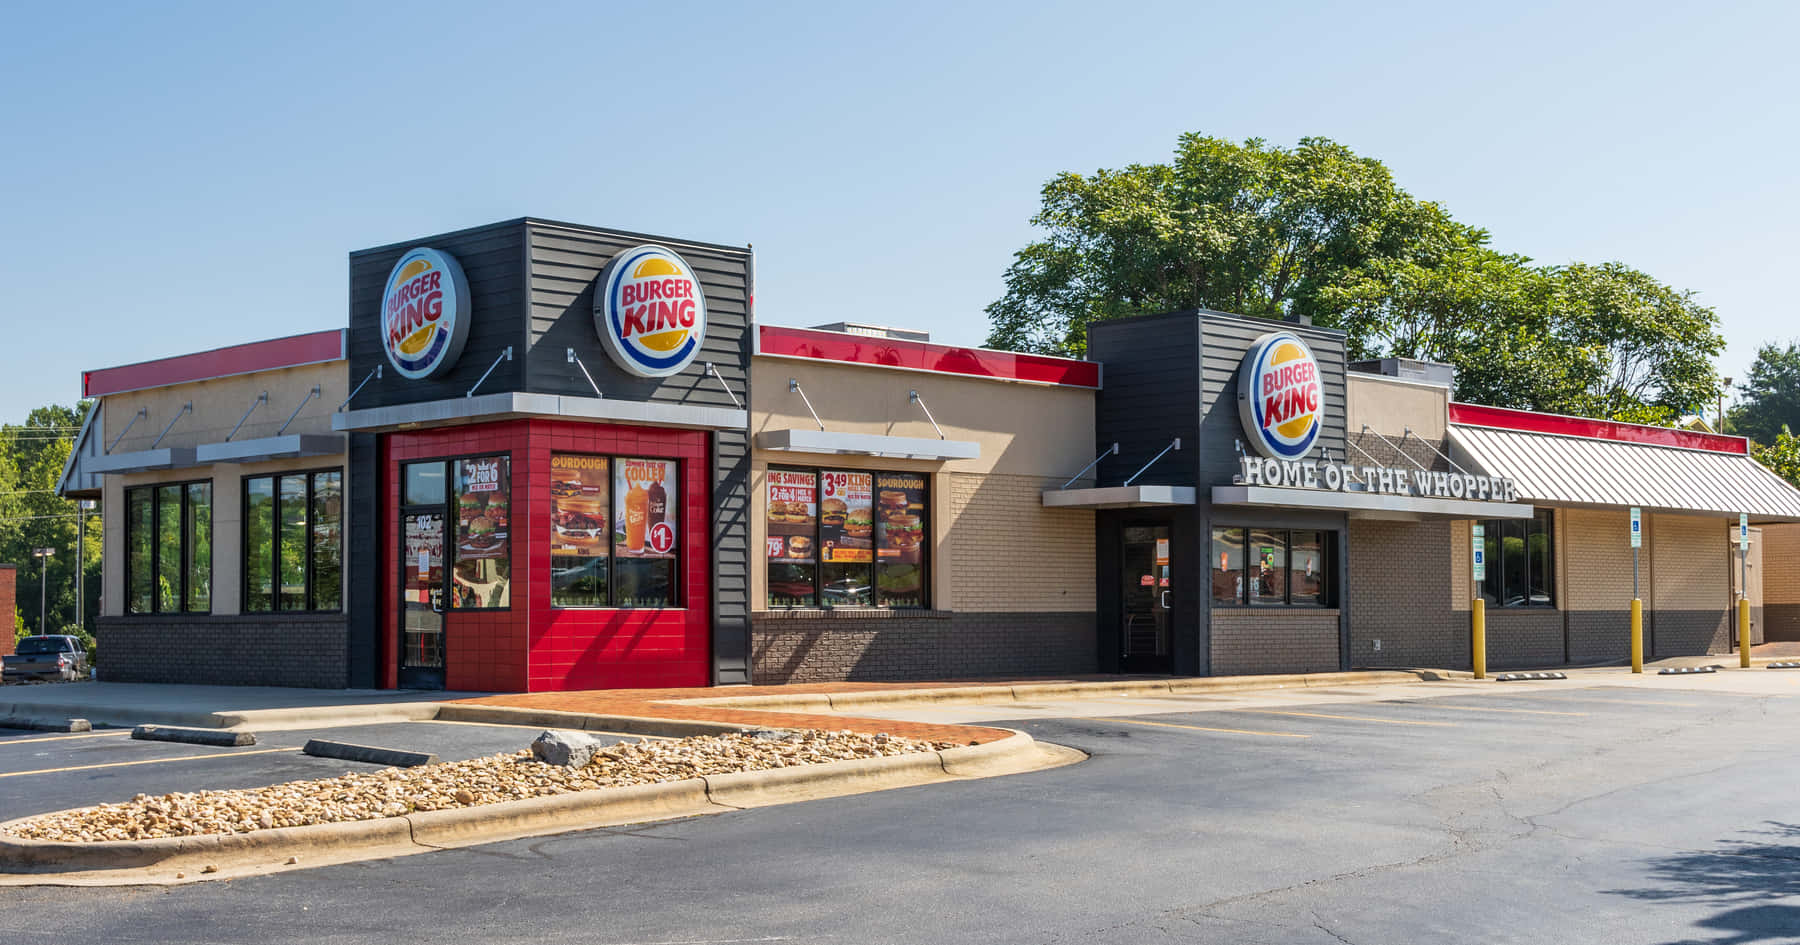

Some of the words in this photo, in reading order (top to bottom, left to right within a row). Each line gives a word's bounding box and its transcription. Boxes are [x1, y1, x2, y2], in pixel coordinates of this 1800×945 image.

[387, 271, 441, 320] BURGER
[622, 279, 693, 307] BURGER
[389, 291, 442, 352] KING
[622, 299, 695, 338] KING
[1263, 362, 1316, 396] BURGER
[1263, 383, 1318, 428] KING
[552, 457, 608, 470] OURDOUGH
[477, 471, 490, 482] FOR
[624, 466, 666, 481] COOLER
[768, 472, 782, 483] ING
[784, 472, 815, 486] SAVINGS
[848, 473, 871, 487] KING
[1243, 456, 1318, 488] HOME
[1325, 464, 1354, 491] OF
[1362, 467, 1409, 493] THE
[1414, 470, 1518, 502] WHOPPER
[878, 478, 924, 489] SOURDOUGH
[772, 487, 778, 501] 2
[418, 515, 431, 529] 102
